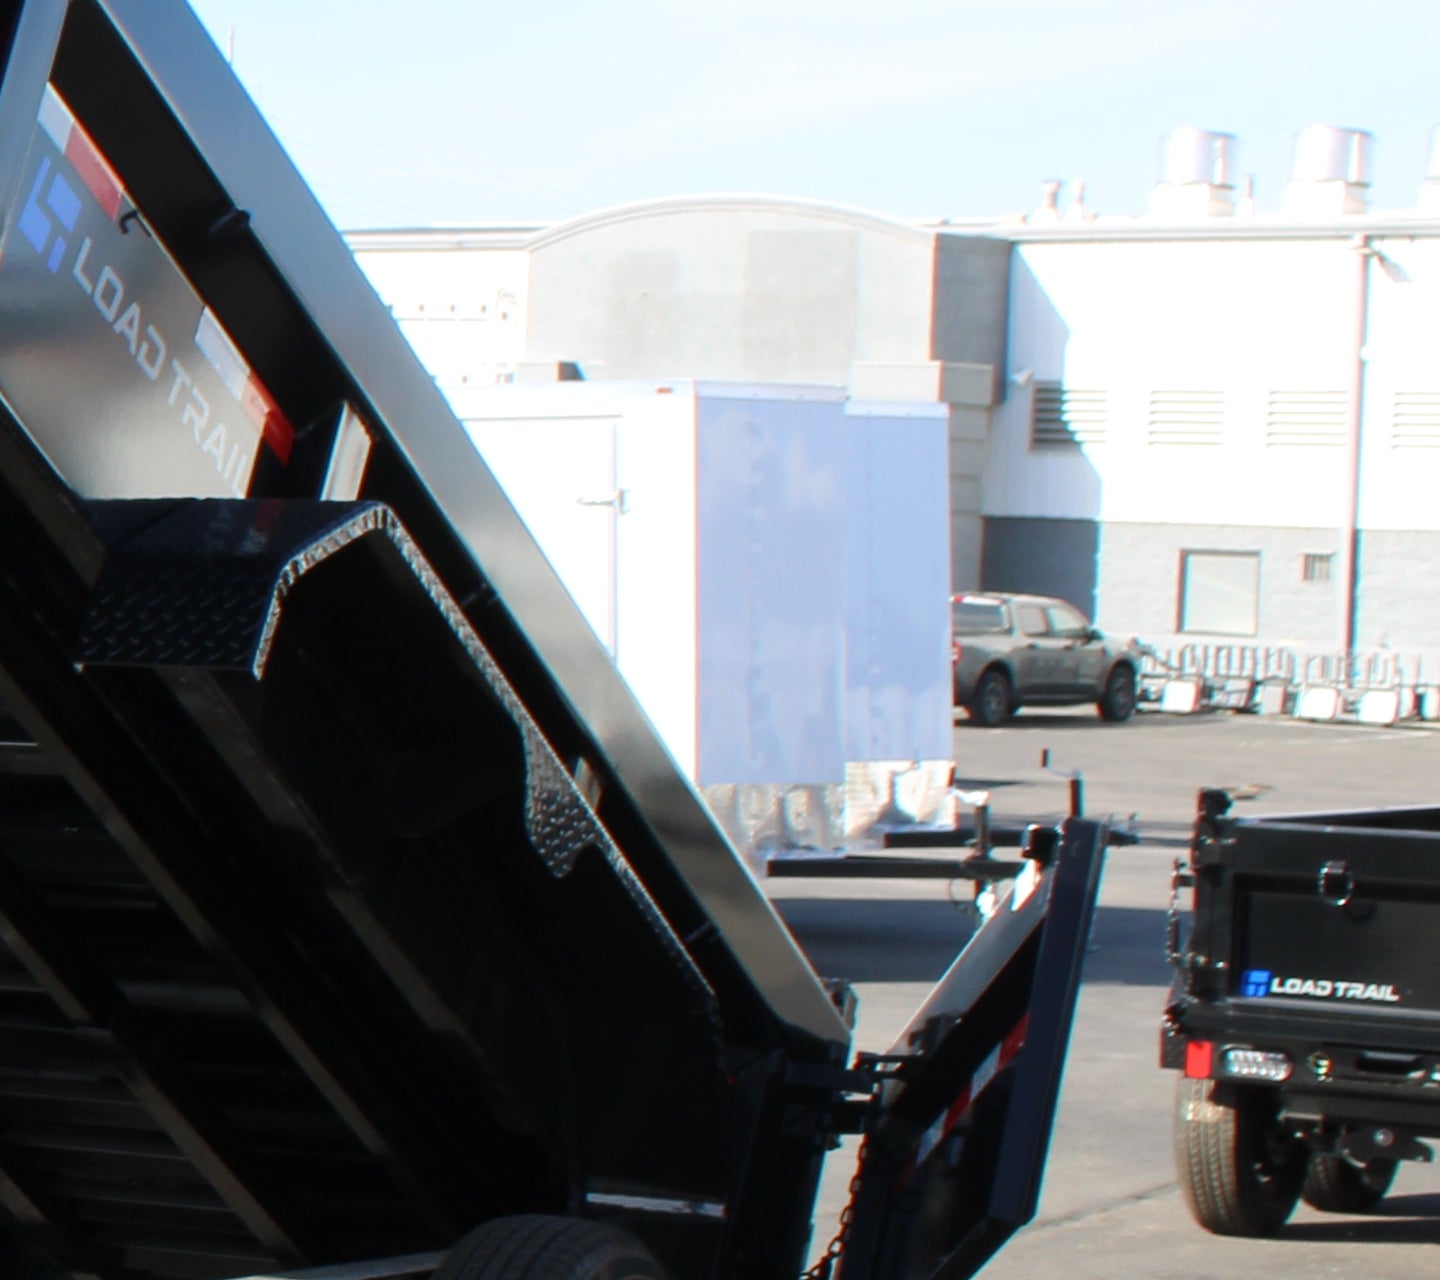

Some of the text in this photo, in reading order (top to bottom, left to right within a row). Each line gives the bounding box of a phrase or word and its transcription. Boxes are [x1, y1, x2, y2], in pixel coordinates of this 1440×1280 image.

[72, 237, 167, 381] LOAD
[1270, 977, 1400, 1002] LOAD TRAIL
